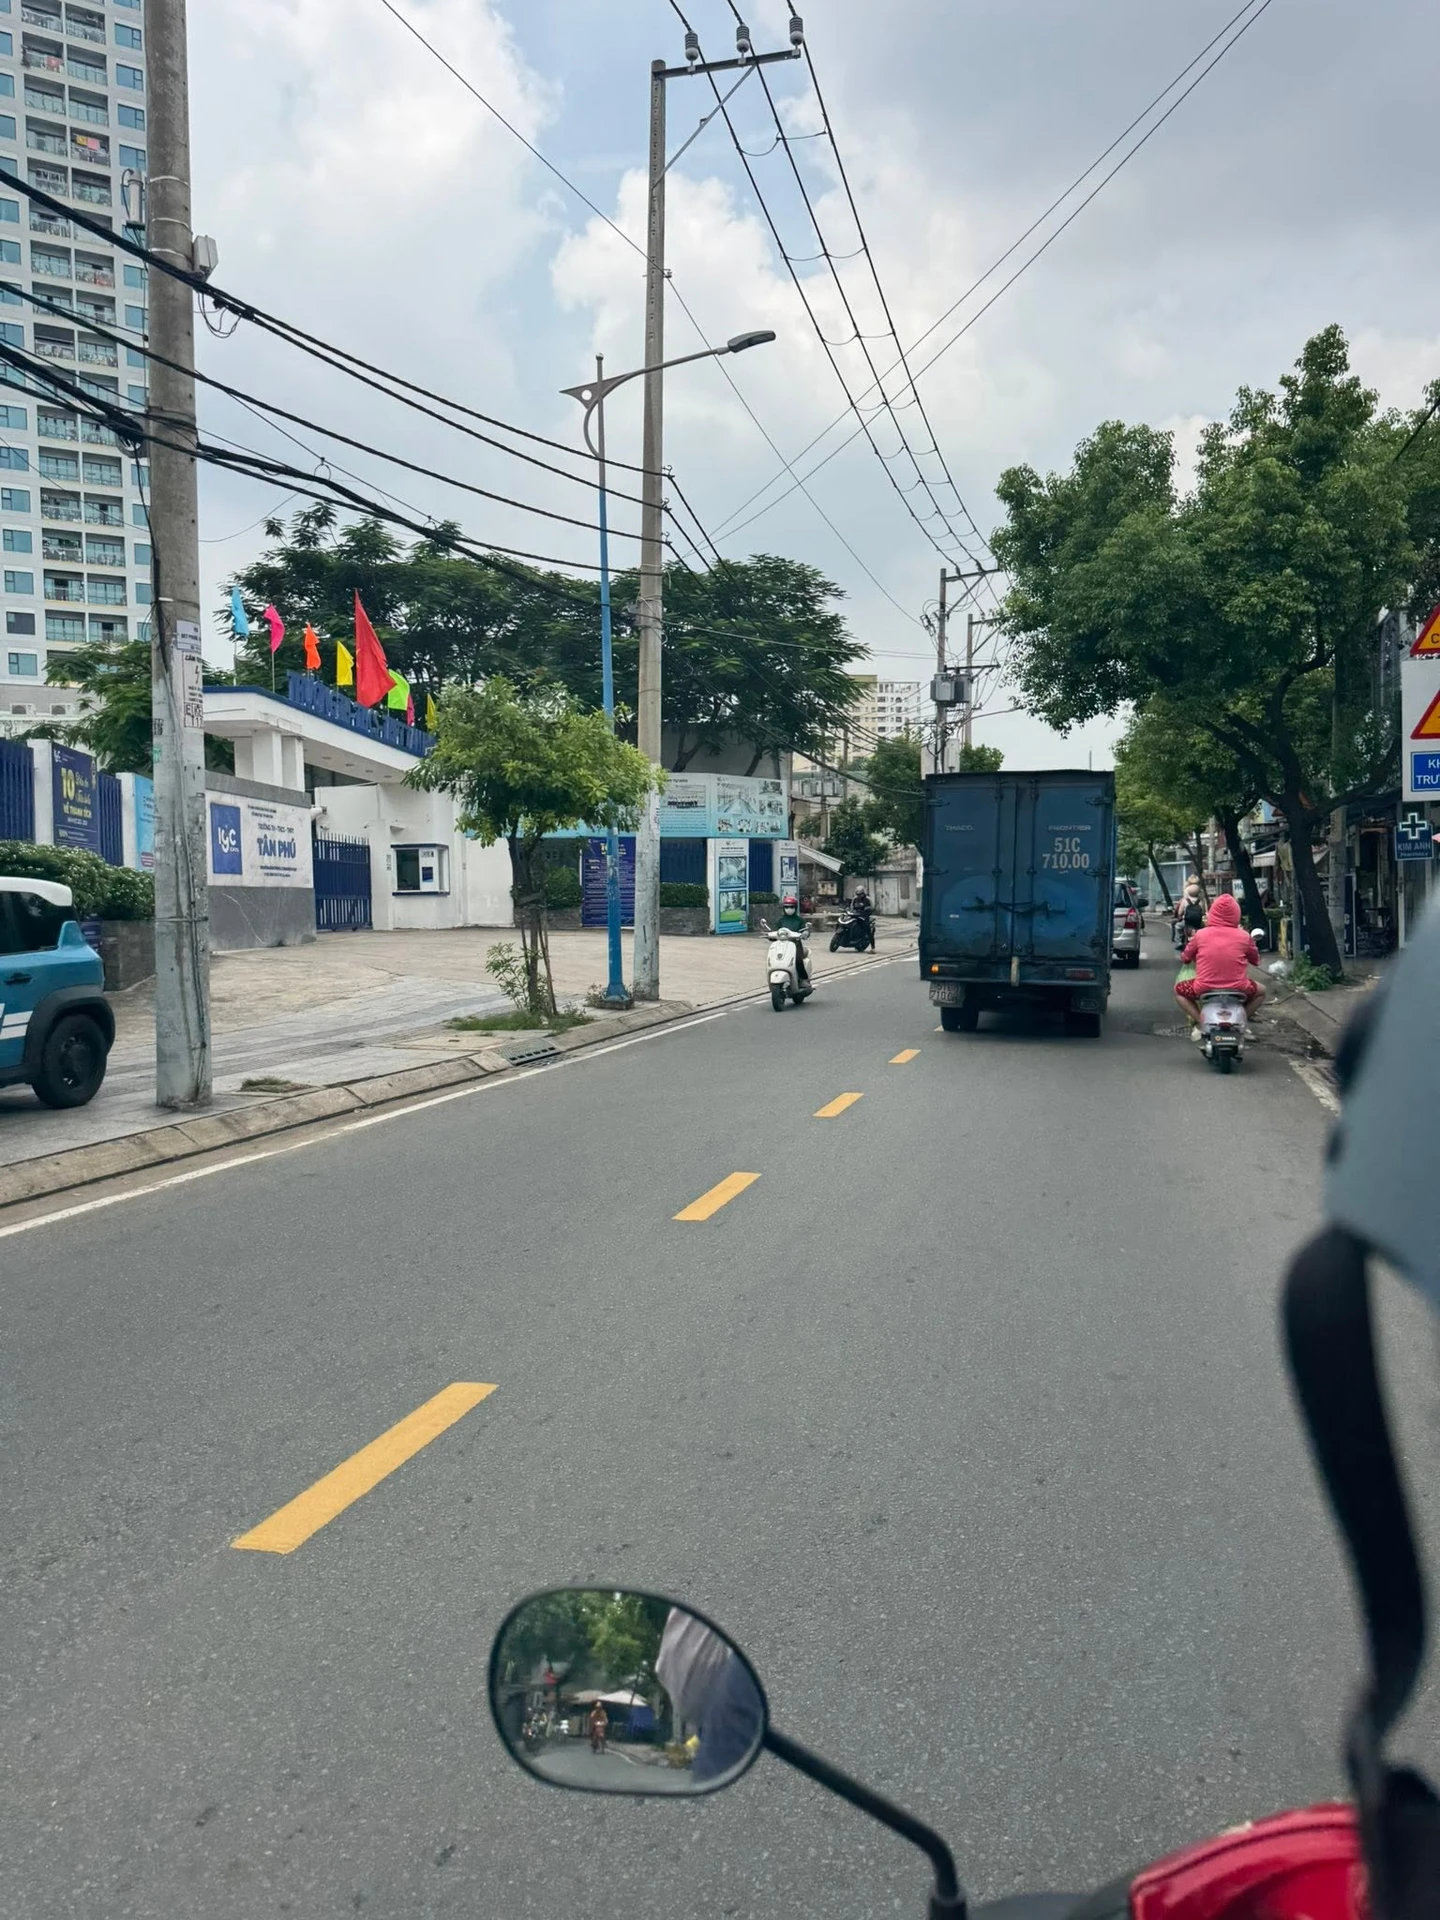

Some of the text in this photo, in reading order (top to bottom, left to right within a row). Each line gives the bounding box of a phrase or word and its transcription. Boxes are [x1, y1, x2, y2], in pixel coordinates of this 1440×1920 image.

[61, 767, 75, 801] 10
[257, 834, 296, 859] TÂN PHÚ
[1054, 837, 1080, 852] 51C
[1398, 841, 1431, 851] KIM ANH
[1042, 853, 1090, 869] 710.00
